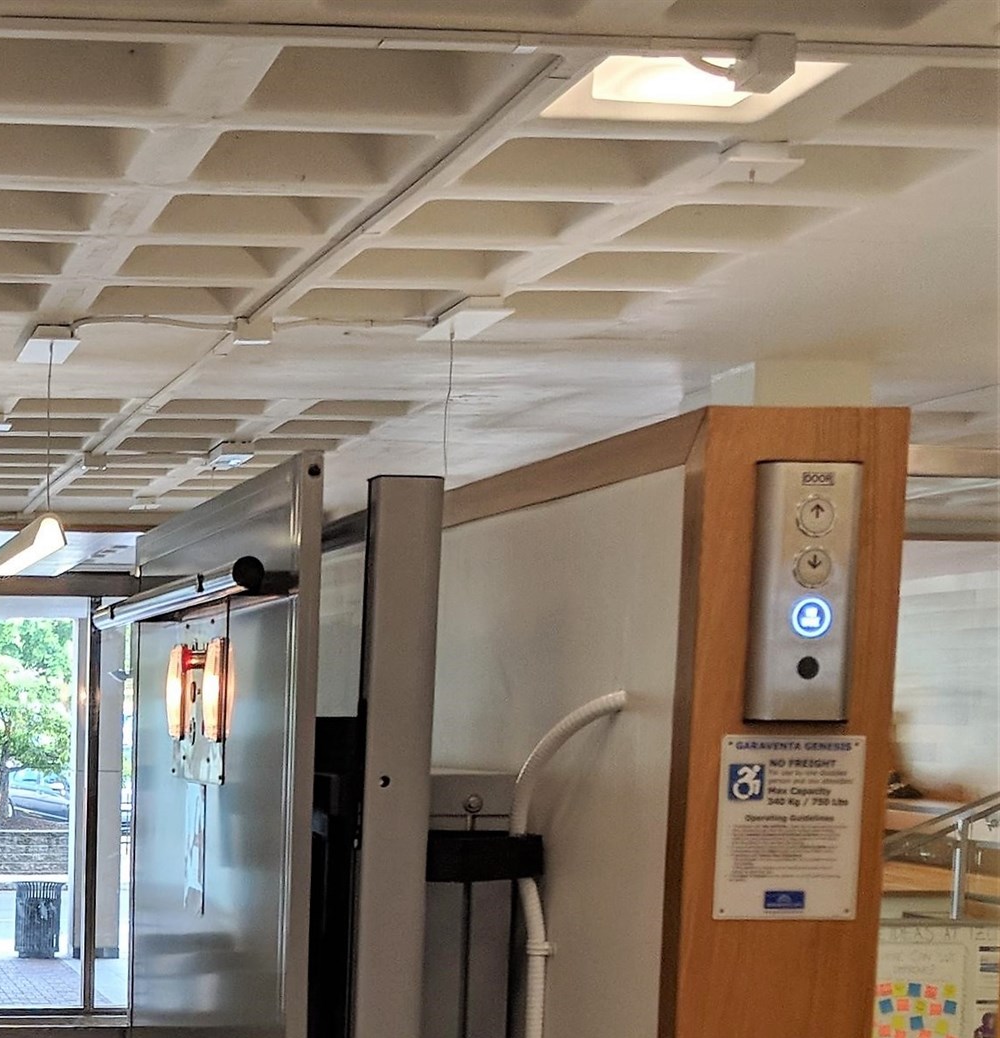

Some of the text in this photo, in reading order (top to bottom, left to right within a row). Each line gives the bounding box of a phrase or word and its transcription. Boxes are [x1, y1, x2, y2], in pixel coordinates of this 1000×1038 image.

[803, 474, 833, 483] DOOR
[736, 741, 853, 751] GARAVENTA GENESIS
[769, 759, 836, 768] NO FREIGHT
[768, 787, 831, 797] Max Capacity
[788, 798, 801, 808] Kg
[812, 798, 830, 806] 750
[744, 814, 835, 823] Operating Guidelines
